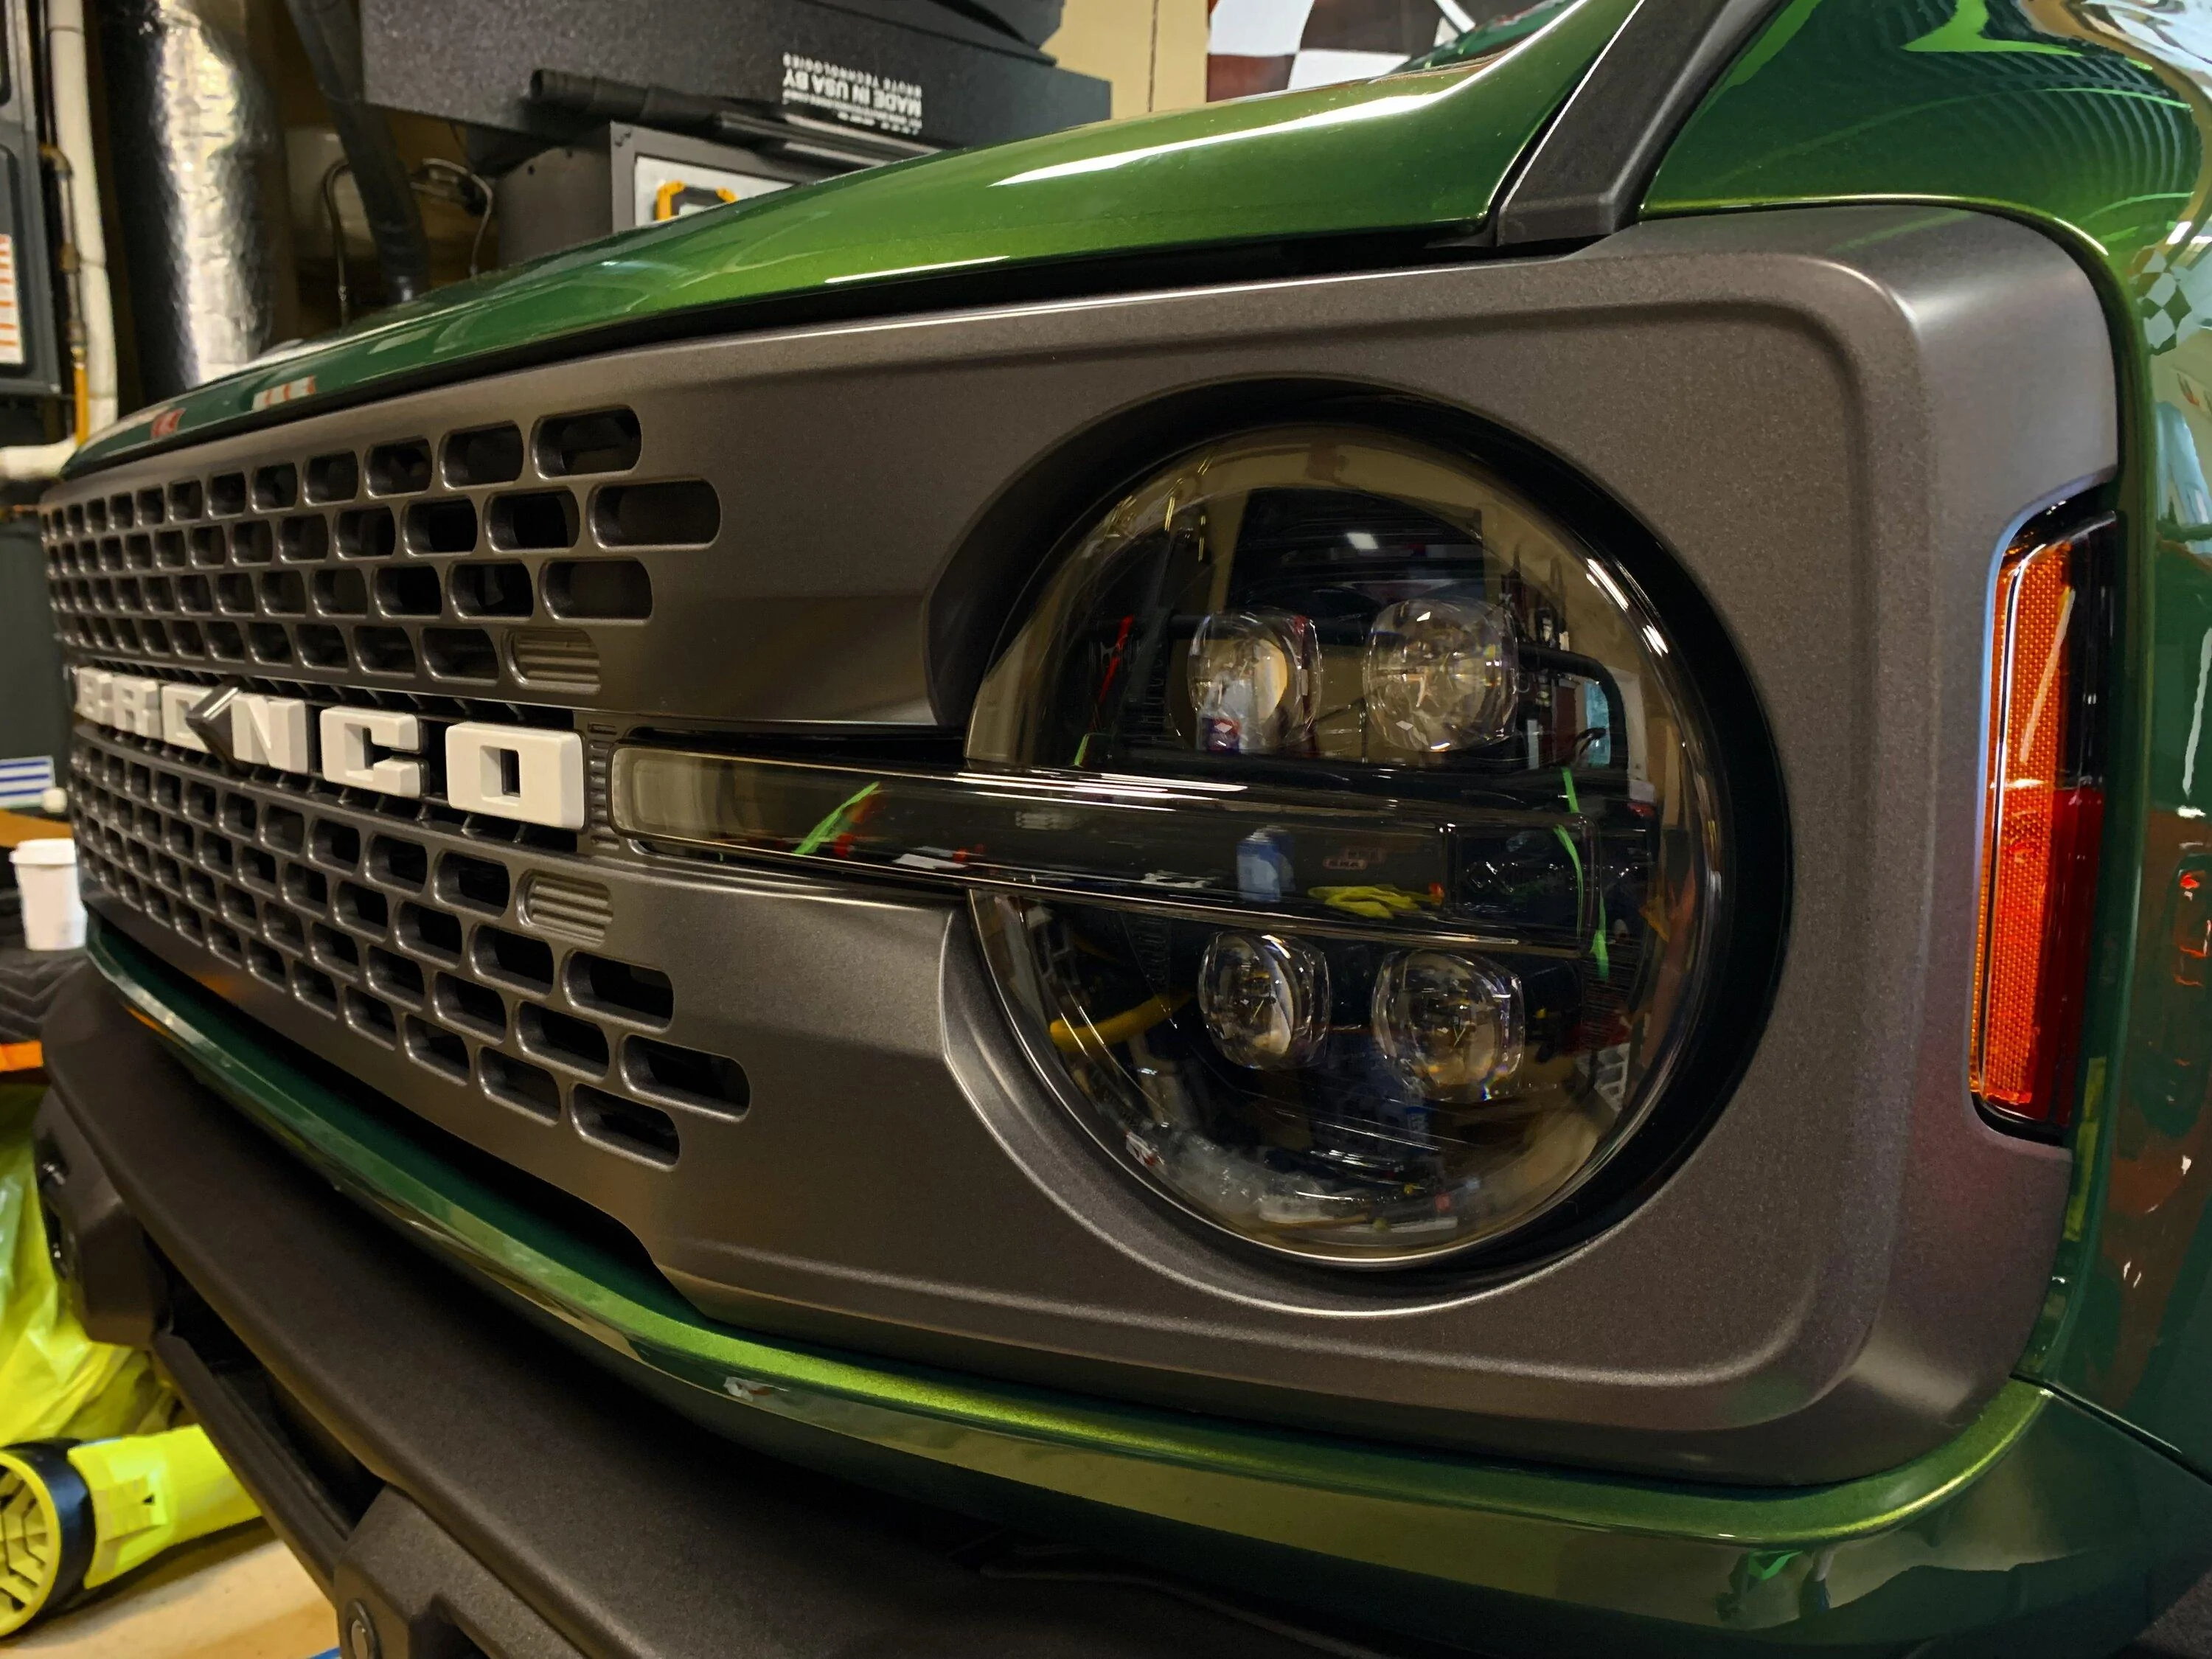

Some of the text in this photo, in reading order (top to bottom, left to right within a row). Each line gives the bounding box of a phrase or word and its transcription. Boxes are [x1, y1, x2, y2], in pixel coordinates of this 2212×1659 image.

[782, 68, 810, 91] BY
[812, 74, 849, 102] USA
[852, 83, 871, 105] IN
[873, 88, 922, 119] MADE
